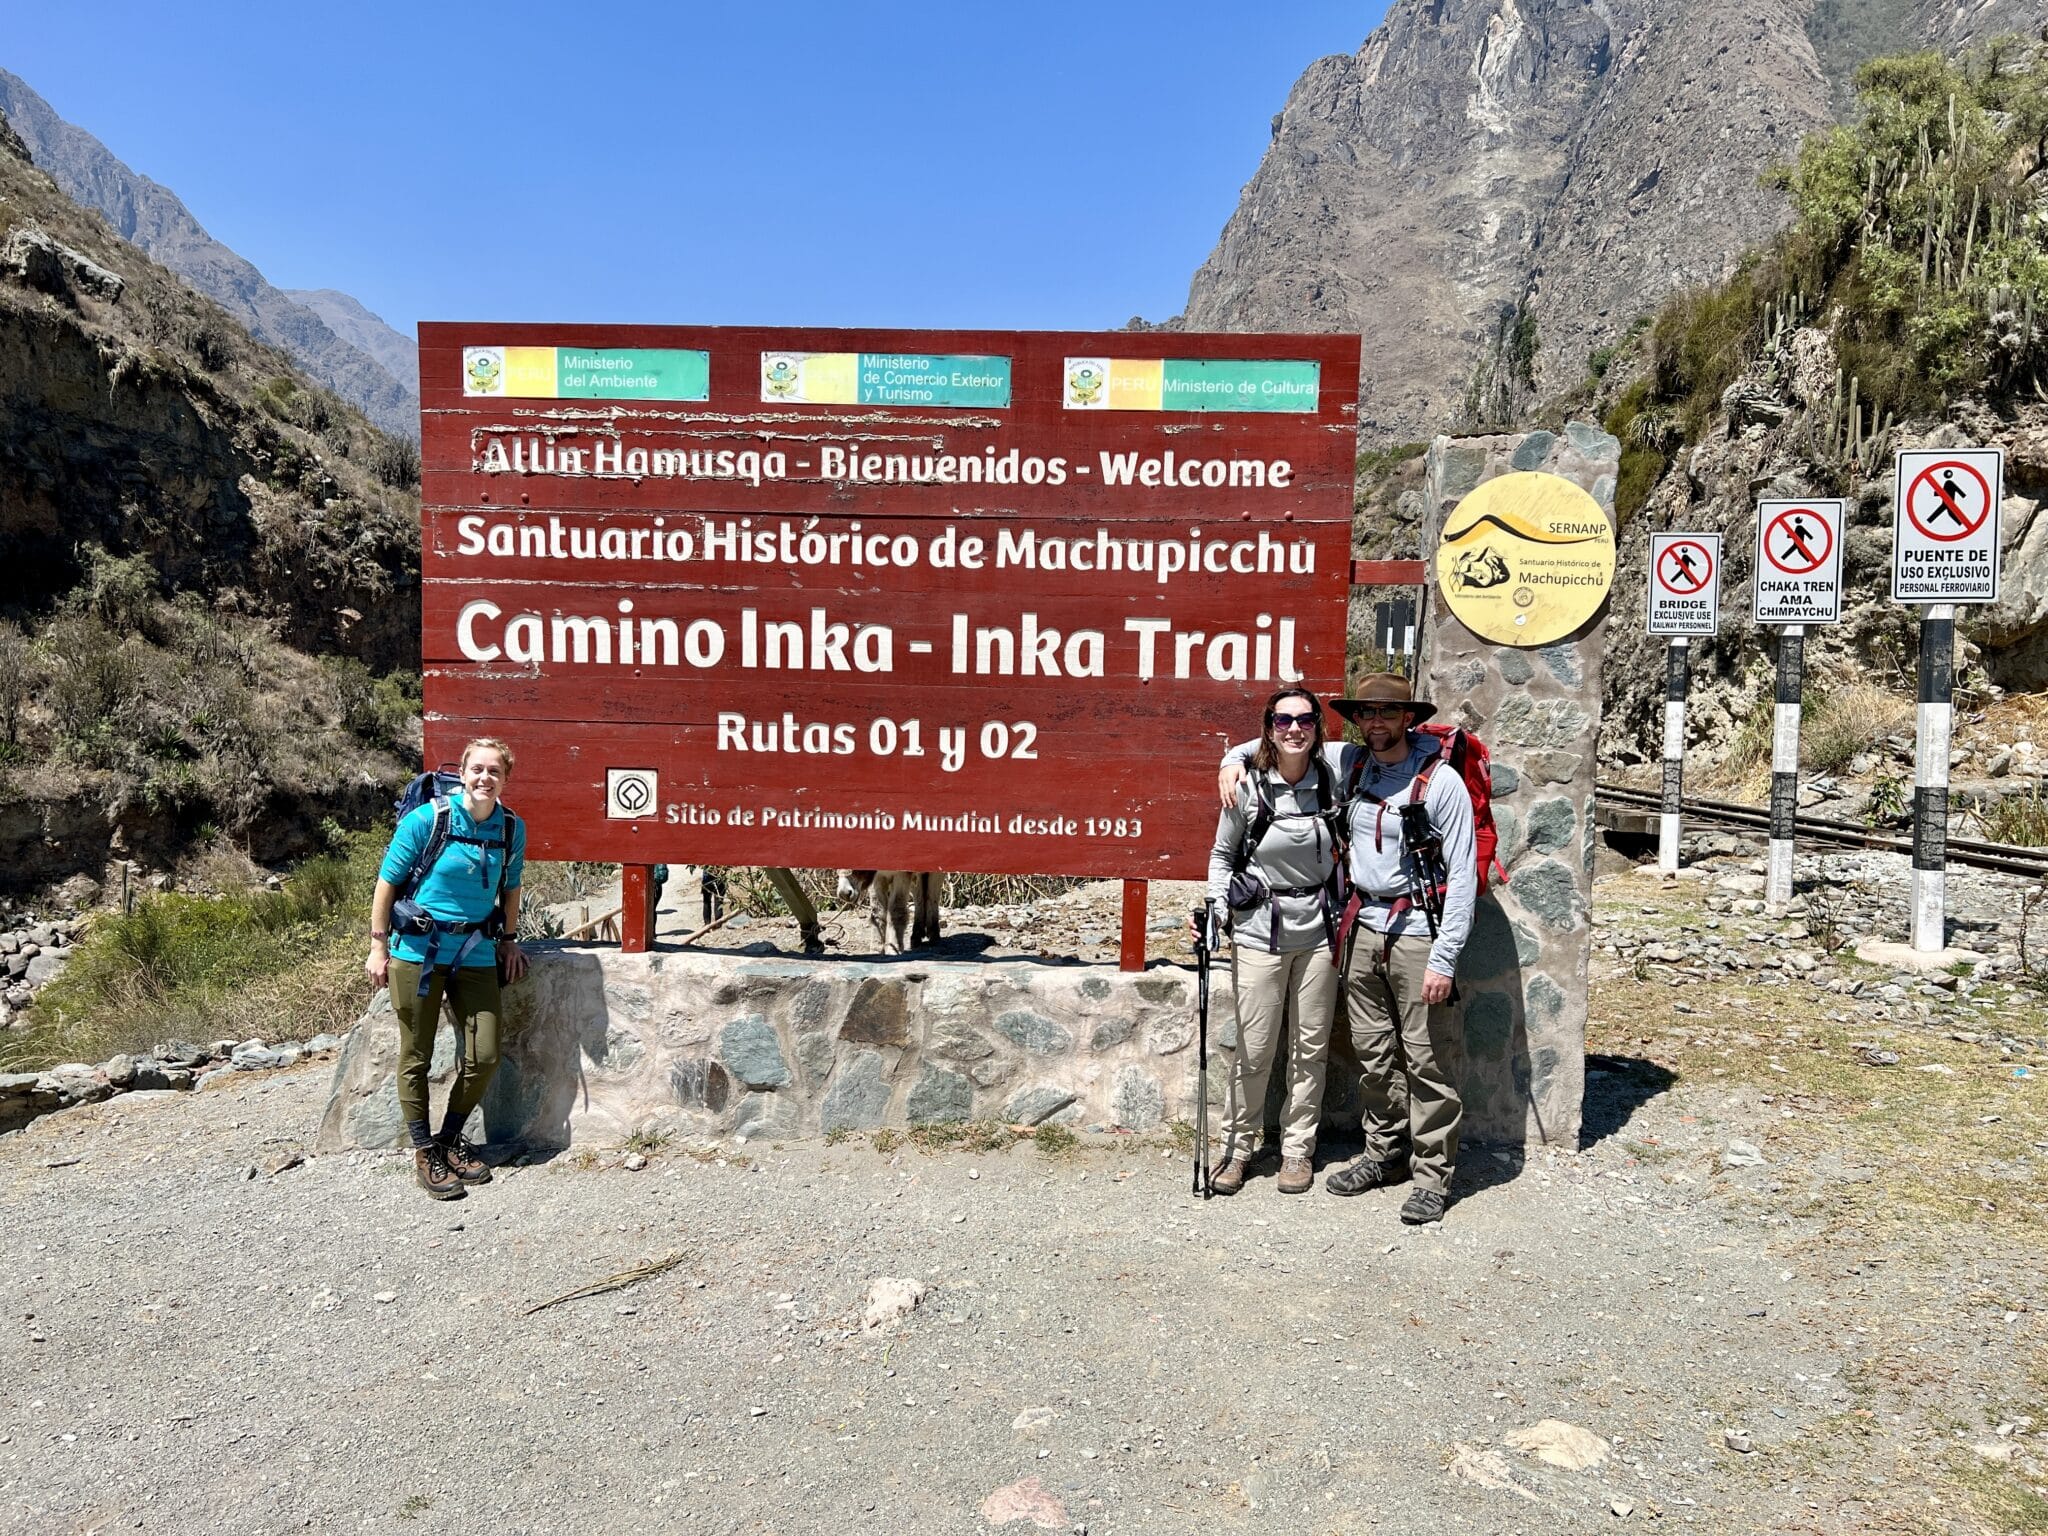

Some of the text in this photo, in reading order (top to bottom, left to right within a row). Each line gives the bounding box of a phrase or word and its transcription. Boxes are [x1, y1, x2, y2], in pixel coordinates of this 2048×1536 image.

[564, 355, 633, 370] Ministerio
[864, 355, 929, 370] Ministerio
[564, 374, 658, 389] del Ambiente
[864, 371, 880, 384] de
[884, 371, 947, 386] Comercio
[952, 373, 1003, 388] Exterior
[1164, 379, 1314, 394] Ministerio de Cultura
[865, 386, 932, 402] y Turismo
[483, 434, 1292, 488] Allin Hamusqa - Bienvenidos - Welcome
[1548, 522, 1607, 535] SERNANP
[457, 515, 1316, 584] Santuario Histórico de Machupicchu
[1904, 549, 1988, 562] PUENTE DE
[1519, 558, 1601, 568] Santuario Histórico de
[1519, 571, 1603, 587] Machupicchu
[1900, 566, 1990, 580] USO EXCLUSIVO
[1760, 581, 1834, 592] CHAKA TREN
[1899, 582, 1990, 593] PERSONAL FERROVIARIO
[1659, 600, 1707, 609] BRIDGE
[1779, 595, 1813, 605] AMA
[1654, 610, 1712, 621] EXCLUSIVE USE
[1759, 606, 1833, 617] CHIMPAYCHU
[1652, 621, 1713, 630] RAILWAY PERSONNEL
[456, 597, 1304, 683] Camino Inka - Inka Trail
[717, 711, 1038, 772] Rutas 01 y 02
[665, 803, 1143, 838] Sitio de Patrimonio Mundial desde 1983
